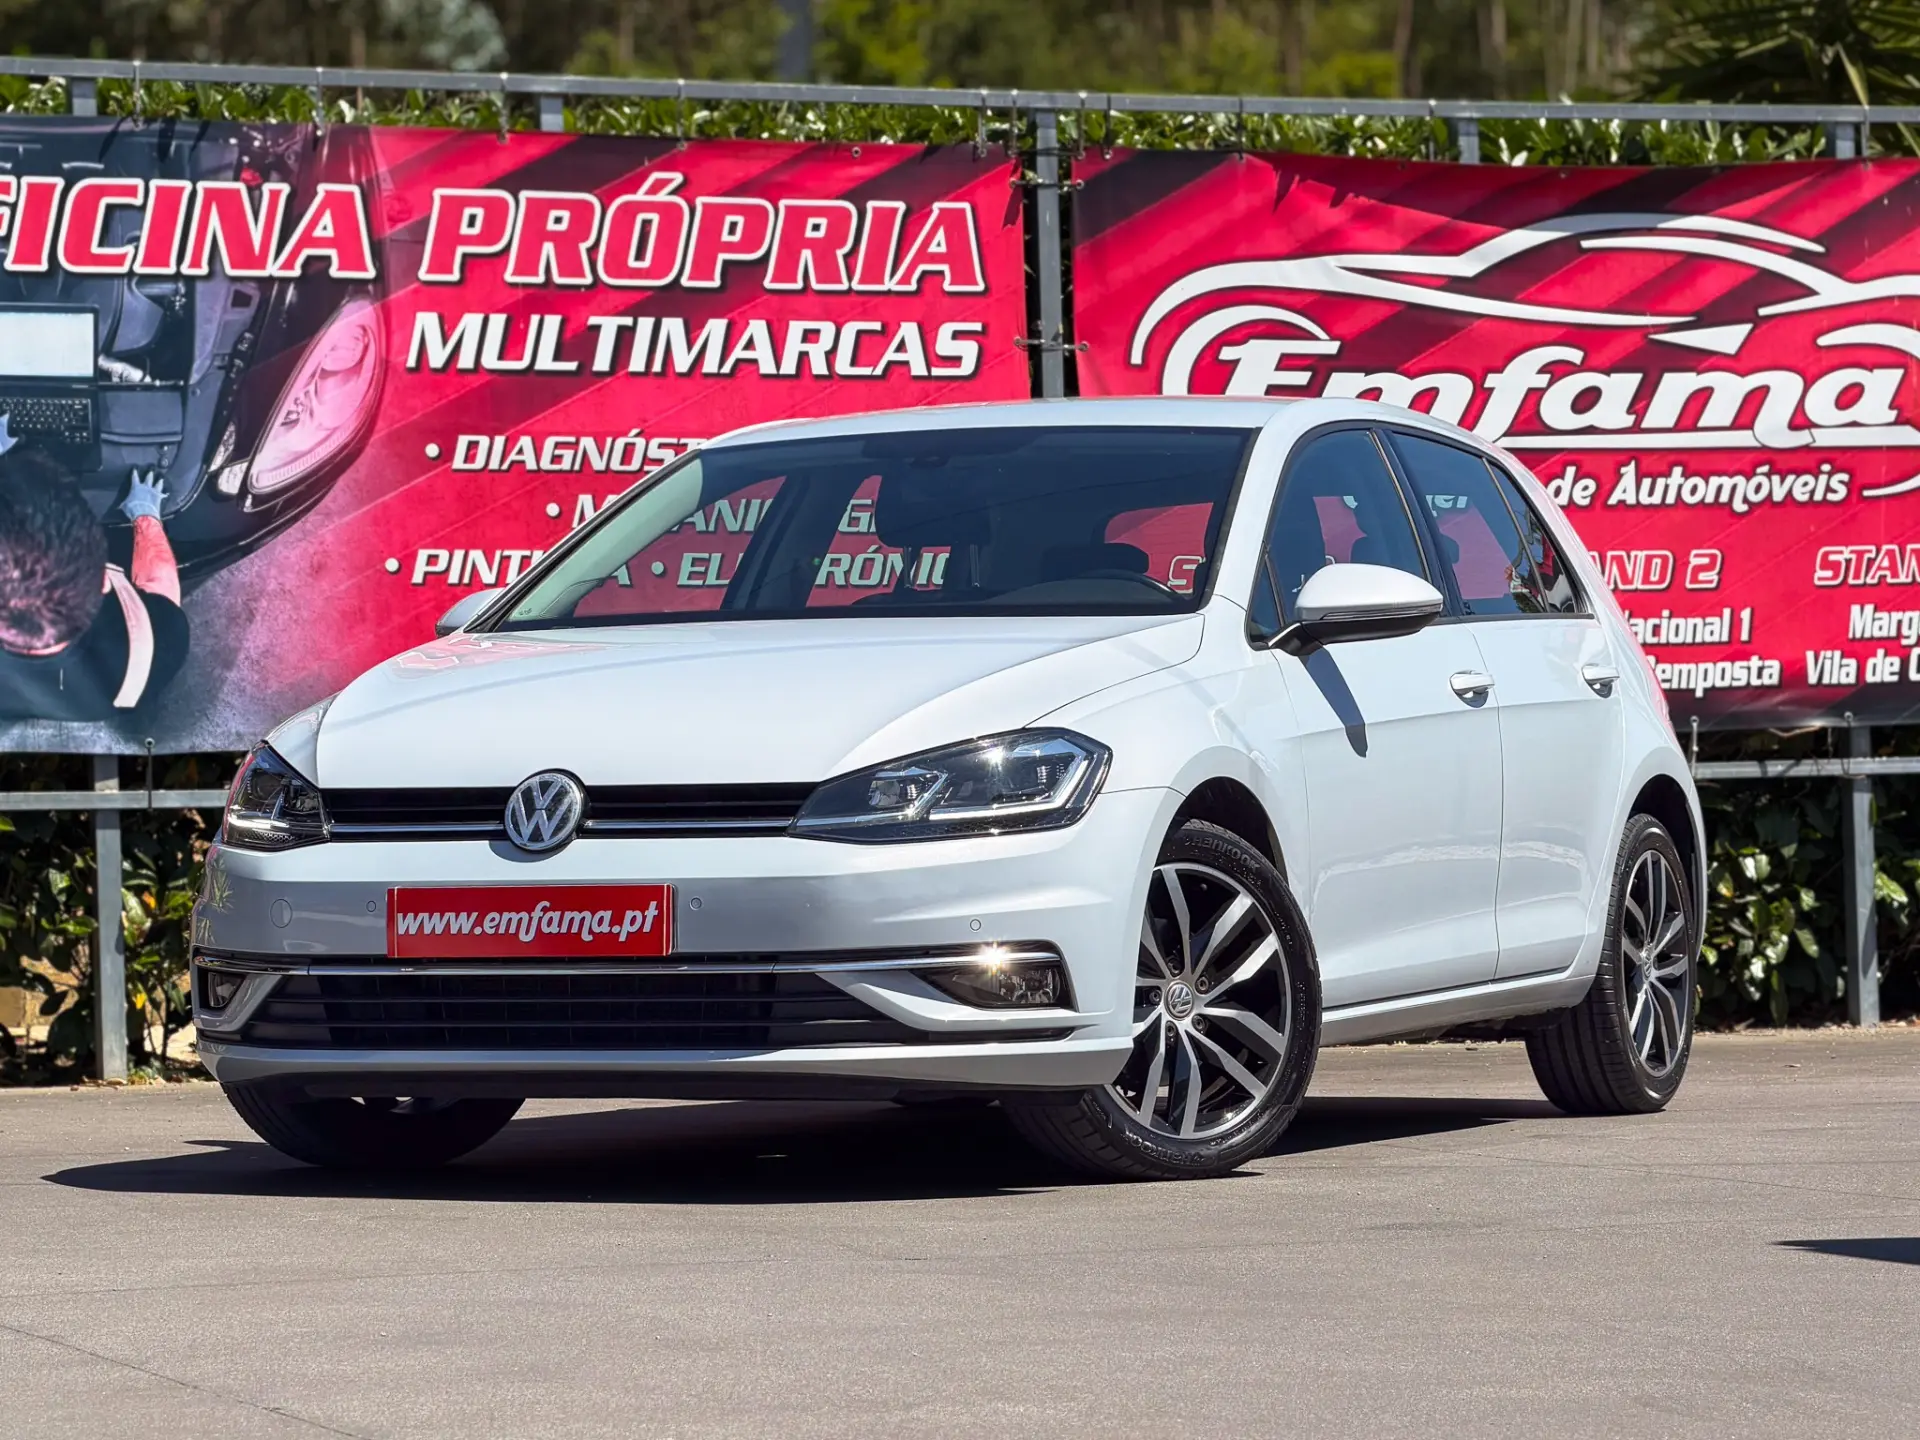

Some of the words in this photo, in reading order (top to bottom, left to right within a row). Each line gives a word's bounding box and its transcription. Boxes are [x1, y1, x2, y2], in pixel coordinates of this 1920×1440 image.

[418, 171, 985, 292] PRÓPRIA
[406, 311, 983, 377] MULTIMARCAS
[1217, 337, 1905, 449] Emfama
[1547, 466, 1597, 507] de
[1685, 549, 1722, 589] 2
[1624, 608, 1732, 645] acional
[1739, 608, 1753, 641] 1
[1805, 650, 1858, 686] Vila
[1865, 648, 1901, 684] de
[396, 900, 659, 942] www.emfama.pt
